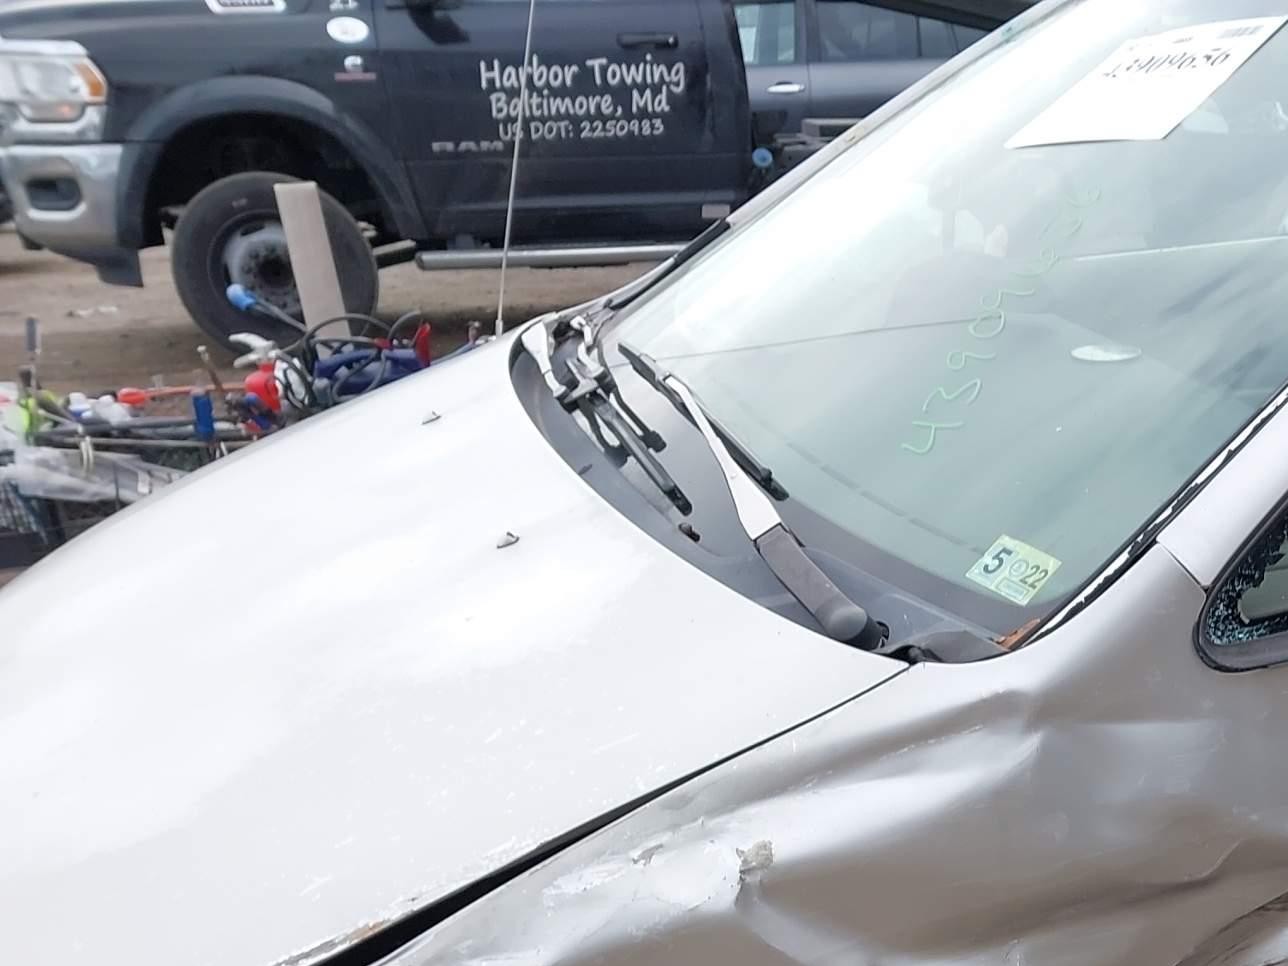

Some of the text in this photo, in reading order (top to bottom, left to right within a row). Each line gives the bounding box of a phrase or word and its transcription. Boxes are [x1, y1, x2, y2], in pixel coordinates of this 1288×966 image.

[480, 53, 685, 92] Harbor Towing
[490, 85, 670, 119] Baltimore, Md
[499, 118, 665, 141] US DOT: 2250983
[983, 547, 1013, 574] 5
[1020, 564, 1049, 590] 22
